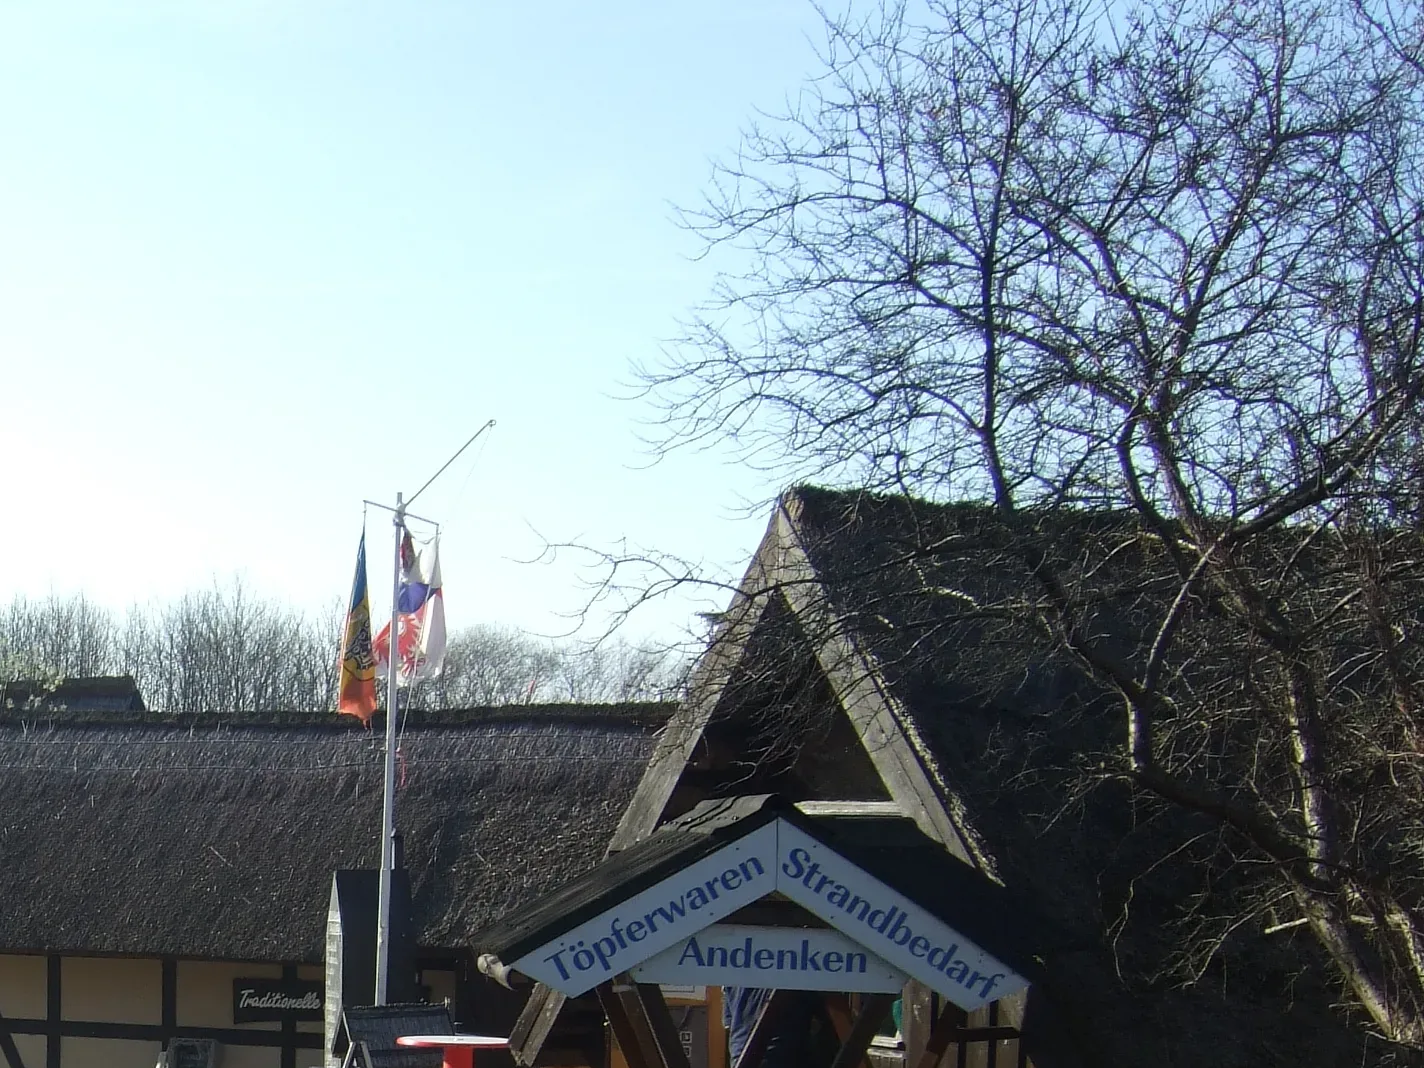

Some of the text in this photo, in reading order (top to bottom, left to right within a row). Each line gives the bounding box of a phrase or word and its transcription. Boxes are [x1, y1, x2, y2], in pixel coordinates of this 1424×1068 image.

[543, 854, 764, 982] Töpferwaren
[678, 937, 867, 974] Andenken
[782, 847, 1005, 1000] Strandbedarf
[239, 988, 321, 1010] Traditionelle
